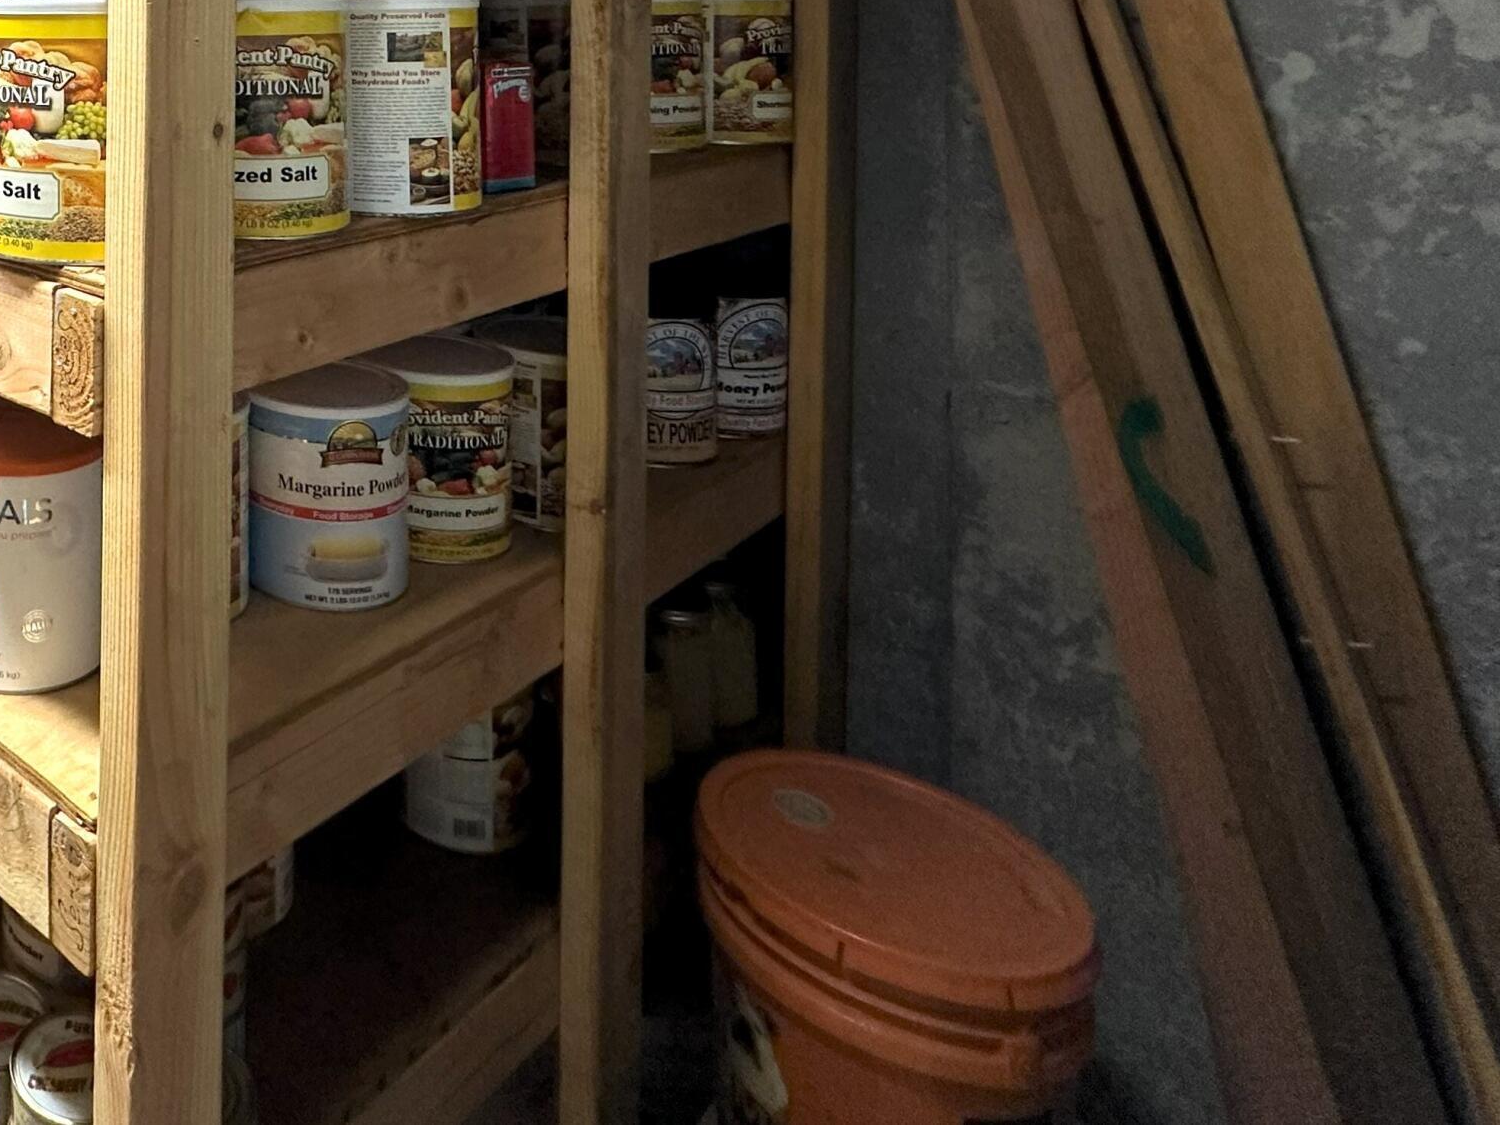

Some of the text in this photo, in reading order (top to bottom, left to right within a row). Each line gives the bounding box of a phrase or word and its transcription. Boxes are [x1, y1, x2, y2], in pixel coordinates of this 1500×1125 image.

[1, 48, 75, 90] Pantry
[277, 44, 333, 80] Pantry
[351, 78, 399, 86] Dehydrated
[280, 165, 318, 183] Salt
[2, 179, 41, 200] Salt
[278, 473, 365, 500] Margarine
[312, 511, 338, 520] Food
[339, 511, 374, 520] Storage
[465, 506, 499, 518] Powder
